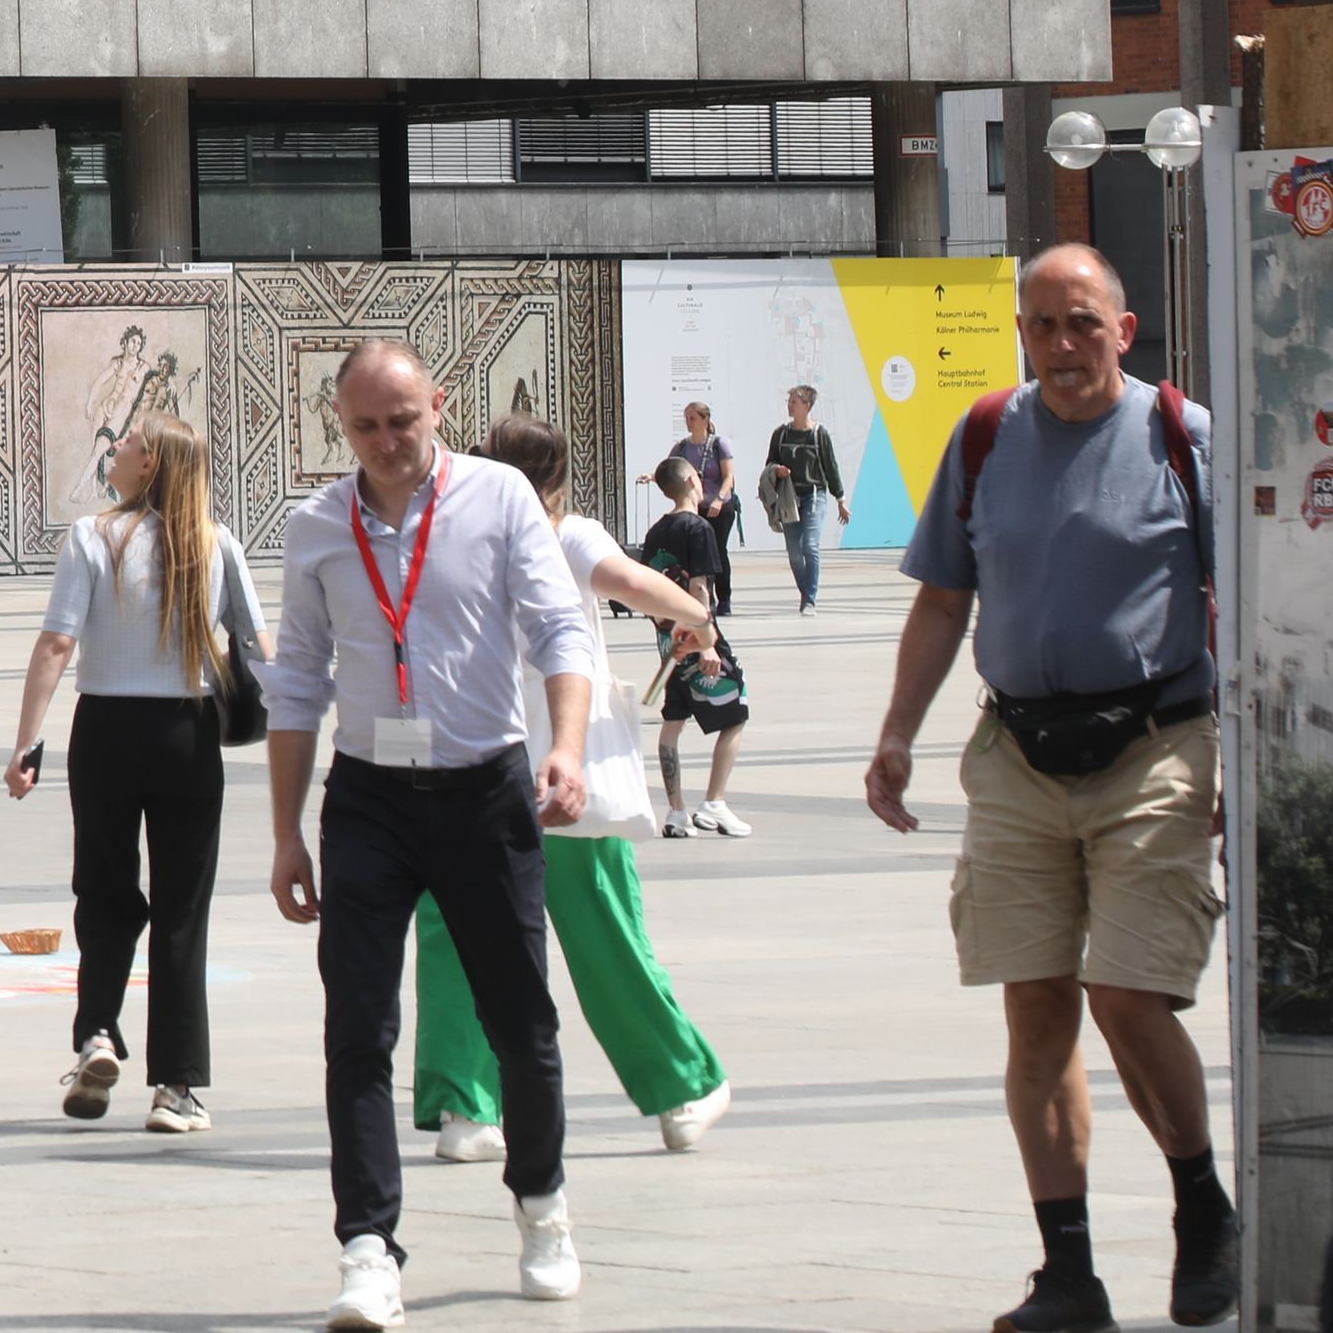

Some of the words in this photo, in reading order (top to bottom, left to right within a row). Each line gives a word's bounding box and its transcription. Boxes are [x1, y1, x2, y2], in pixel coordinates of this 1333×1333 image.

[911, 140, 935, 151] BMZ
[964, 310, 987, 319] Ludwig
[936, 326, 957, 334] Kölner
[958, 325, 1000, 334] Philharmonie
[938, 369, 986, 378] Hauptbahnhof
[964, 379, 988, 387] Station
